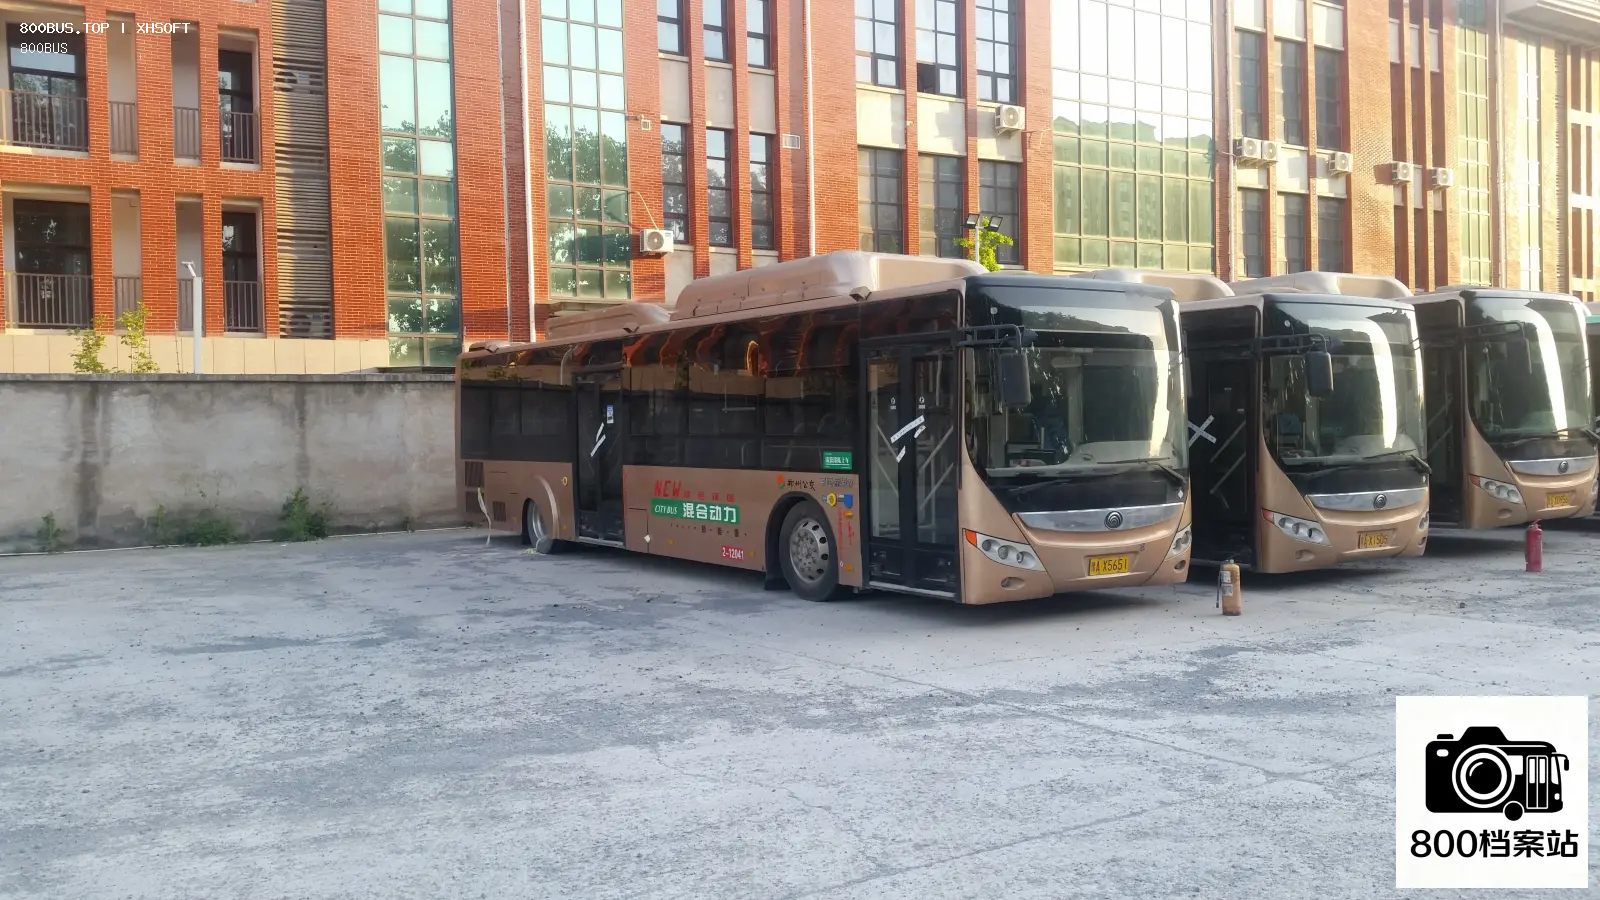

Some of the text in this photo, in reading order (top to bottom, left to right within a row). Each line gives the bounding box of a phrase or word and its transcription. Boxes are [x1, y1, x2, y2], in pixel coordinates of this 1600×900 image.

[653, 480, 682, 497] NEW
[682, 502, 737, 523] 混合动力
[722, 546, 745, 561] 2-12041
